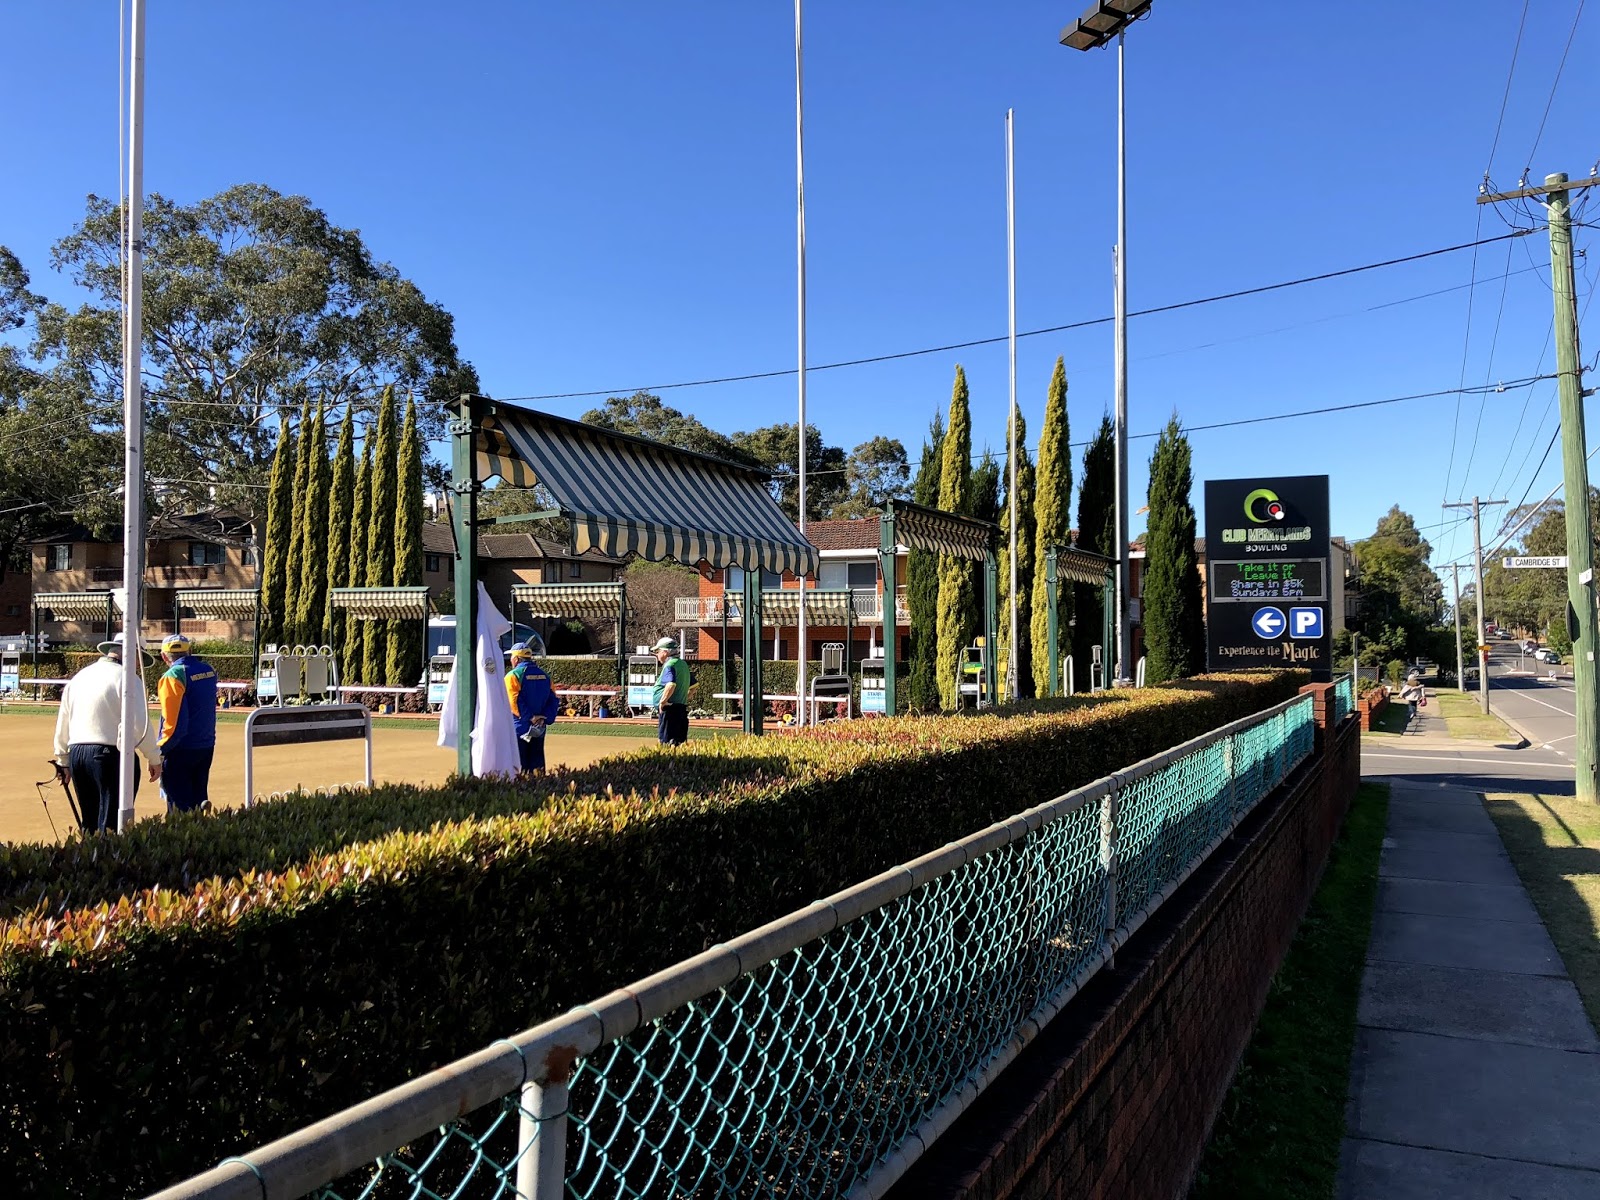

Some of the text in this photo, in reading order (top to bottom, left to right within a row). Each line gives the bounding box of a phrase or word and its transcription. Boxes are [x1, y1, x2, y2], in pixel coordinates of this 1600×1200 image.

[1222, 529, 1247, 542] CLUB
[1245, 544, 1288, 552] BOWLING
[1237, 562, 1296, 572] Take it or
[1515, 558, 1551, 566] CAMBRIDGE
[1552, 558, 1561, 566] ST
[1244, 571, 1293, 580] Leave it
[1230, 578, 1305, 589] Share in $5K
[1296, 611, 1317, 634] P
[1218, 641, 1320, 662] Experience the Magic
